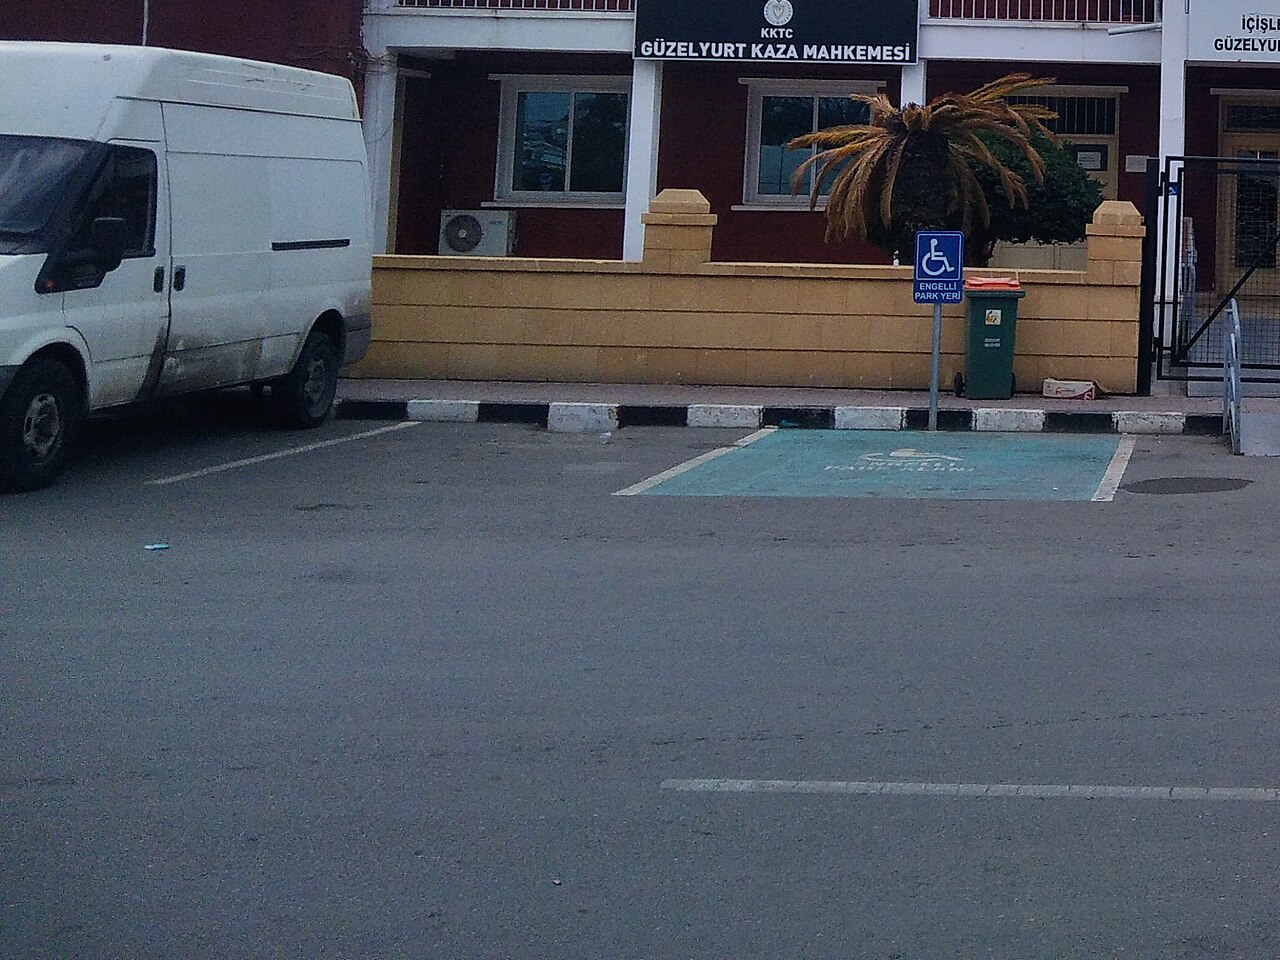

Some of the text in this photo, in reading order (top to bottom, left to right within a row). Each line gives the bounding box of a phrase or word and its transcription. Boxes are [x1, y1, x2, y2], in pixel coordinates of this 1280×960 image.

[760, 27, 794, 39] KKTC
[640, 38, 910, 61] GÜZELYURT KAZA MAHKEMESİ
[914, 290, 961, 300] PARK YERİ
